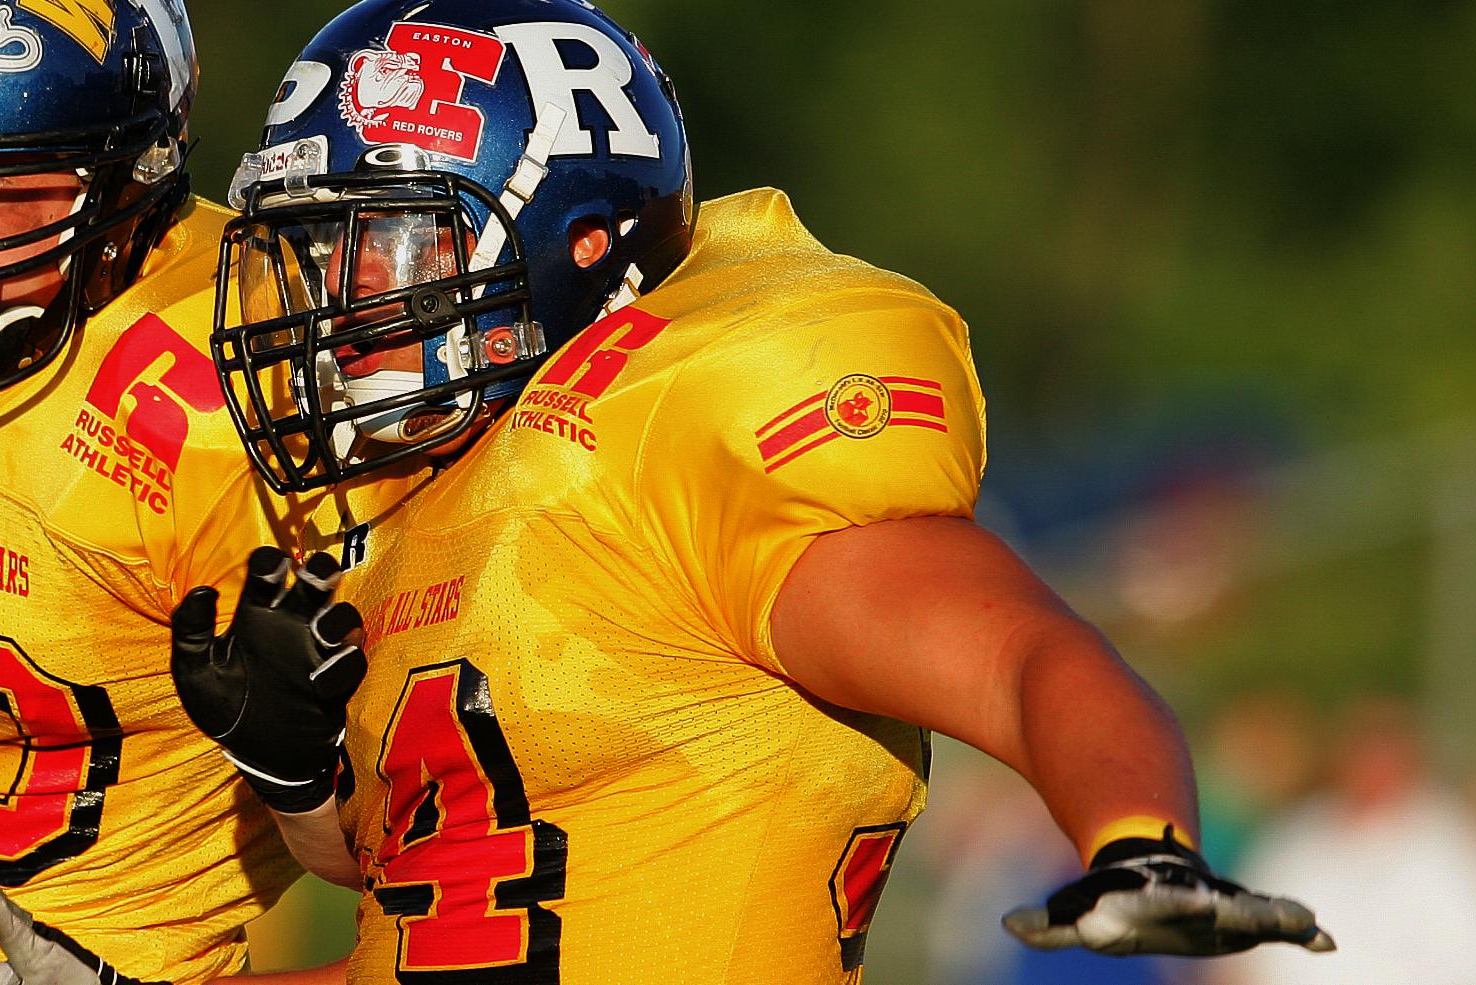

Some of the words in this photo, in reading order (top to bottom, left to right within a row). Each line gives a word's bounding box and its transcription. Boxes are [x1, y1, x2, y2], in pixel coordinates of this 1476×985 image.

[412, 32, 472, 49] EASTON
[392, 120, 416, 132] RED
[417, 124, 463, 142] ROVERS
[521, 390, 593, 424] RUSSELL
[60, 433, 169, 515] ATHLETIC
[75, 409, 172, 492] RUSSELL
[386, 589, 419, 636] ALL
[413, 575, 465, 629] STARS
